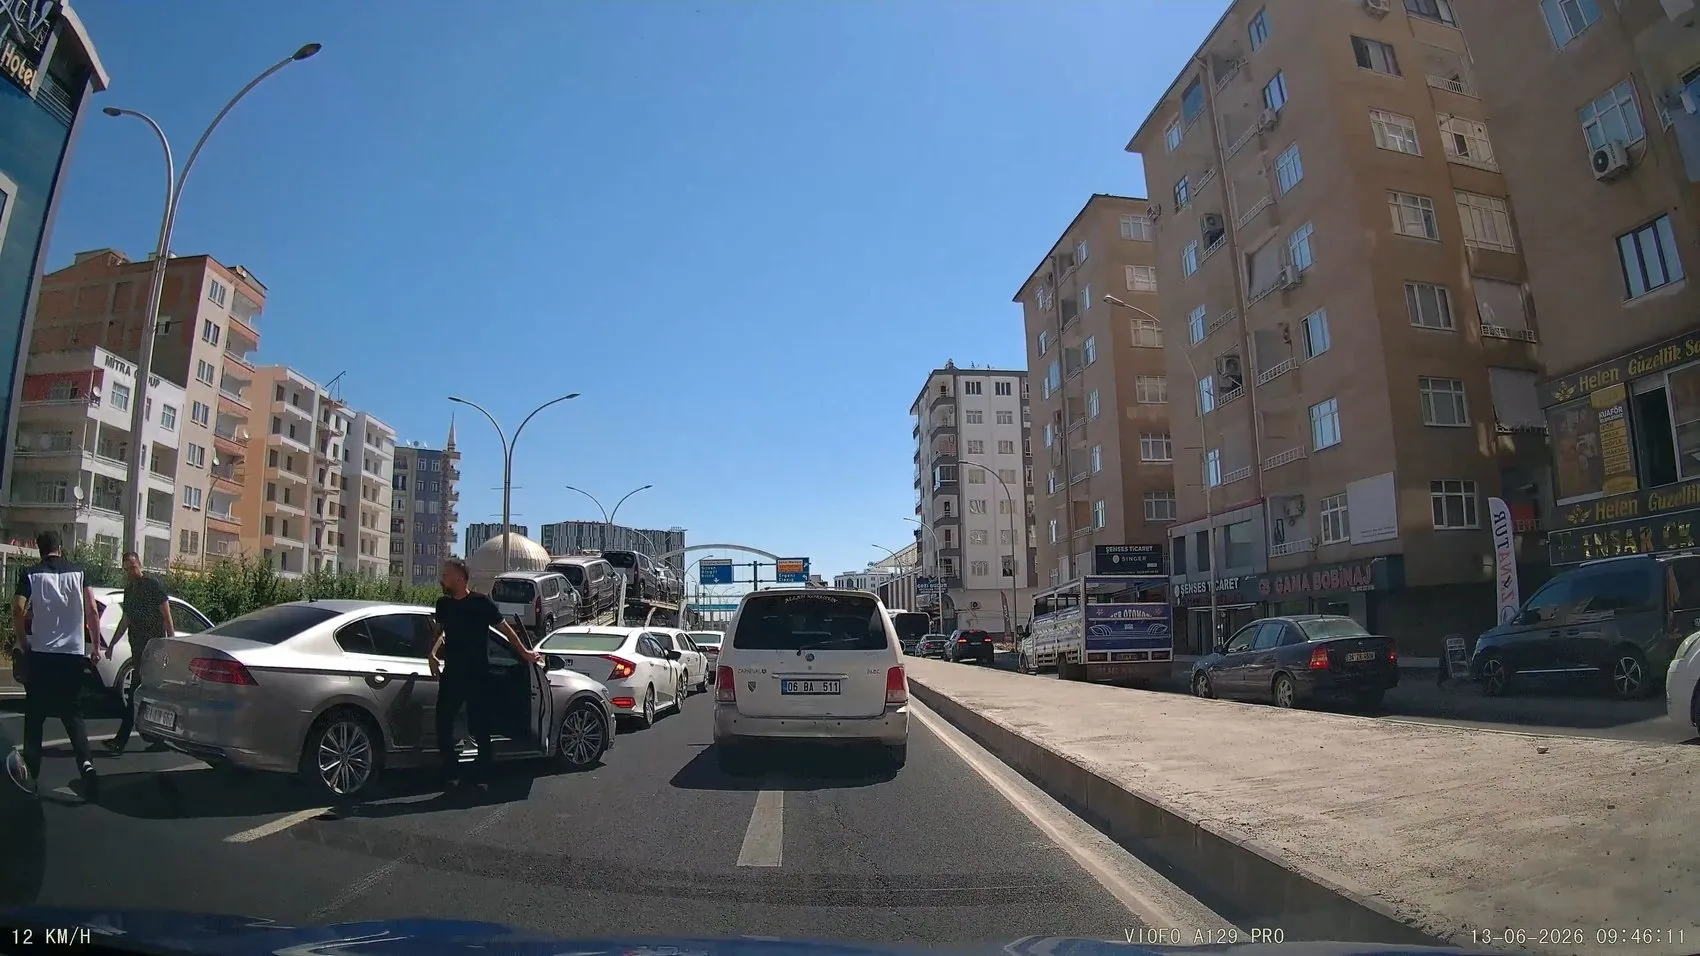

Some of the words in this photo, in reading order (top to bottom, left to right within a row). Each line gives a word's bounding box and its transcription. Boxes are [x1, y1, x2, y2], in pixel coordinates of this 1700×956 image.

[1, 43, 38, 91] Hotel
[105, 354, 131, 377] MİTRA
[1579, 367, 1619, 393] Helen
[1628, 345, 1681, 376] Güzellik
[1596, 499, 1637, 520] Helen
[1180, 581, 1206, 598] ŞENSES
[1207, 577, 1239, 592] TCARET
[787, 682, 798, 692] 06
[803, 682, 814, 692] BA
[823, 682, 838, 692] 511
